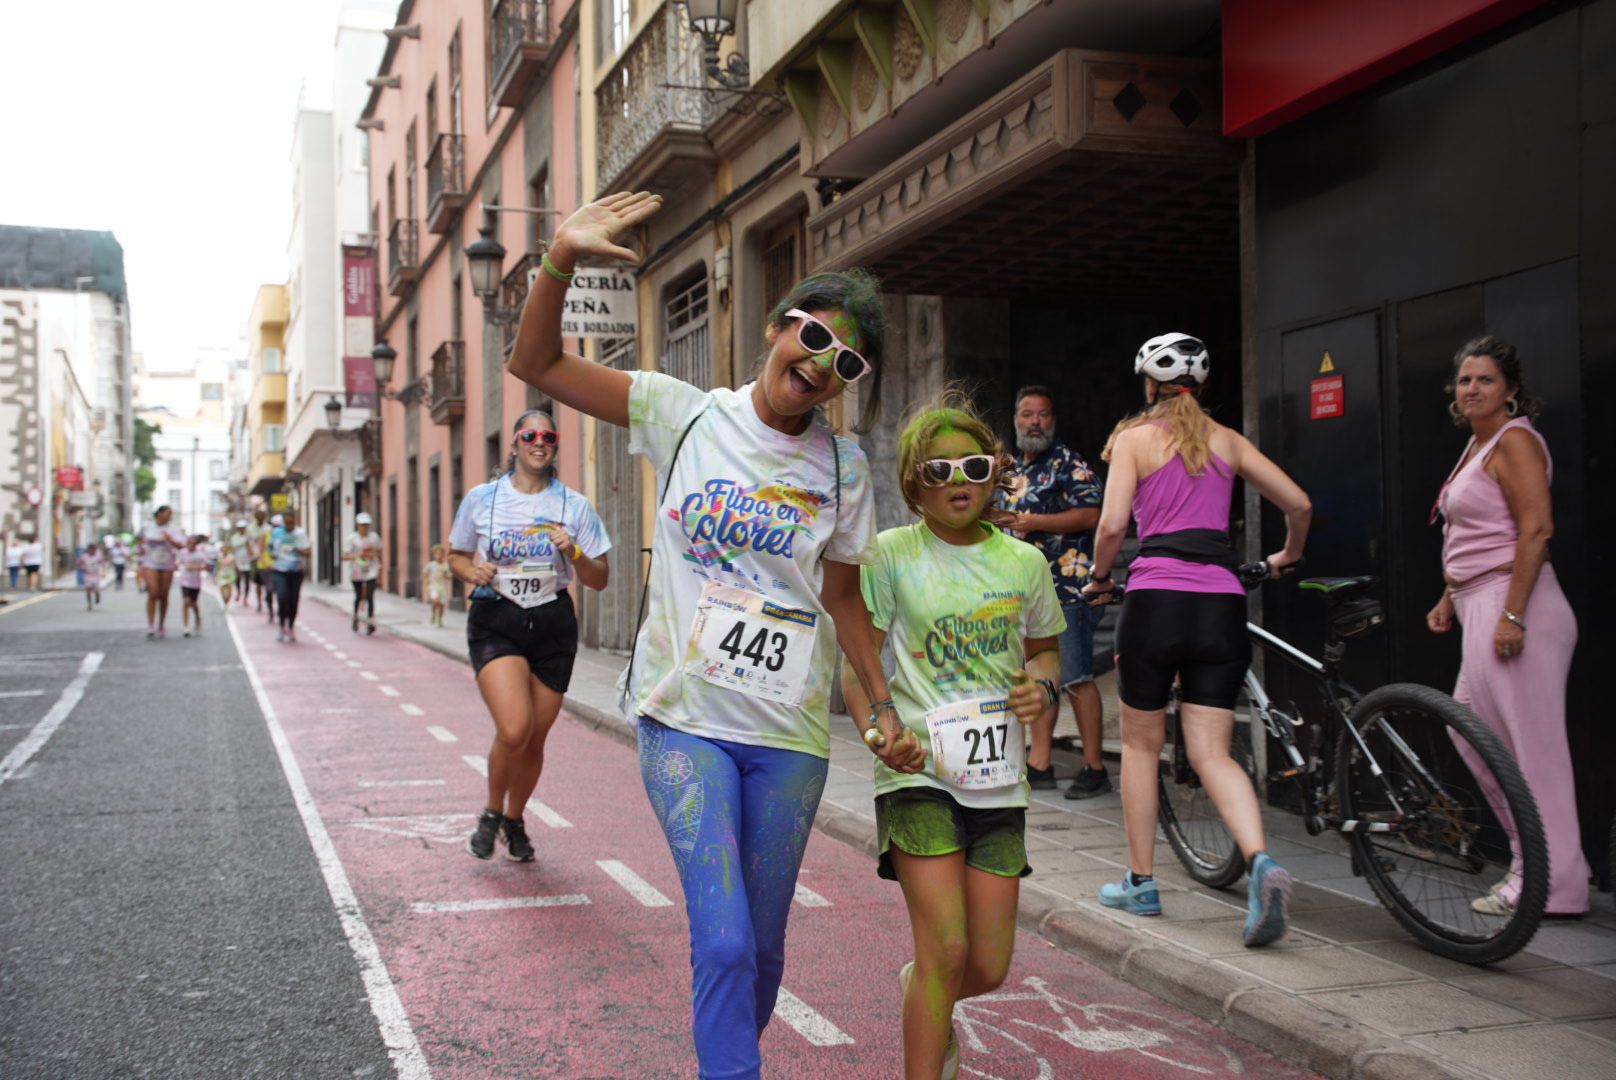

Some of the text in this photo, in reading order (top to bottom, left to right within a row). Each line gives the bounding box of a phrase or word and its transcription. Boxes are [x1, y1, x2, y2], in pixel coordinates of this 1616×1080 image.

[583, 322, 636, 334] BORDADOS
[705, 479, 773, 517] Flipa
[681, 493, 796, 559] Colores
[510, 578, 541, 596] 379
[719, 620, 788, 672] 443
[963, 724, 1008, 766] 217
